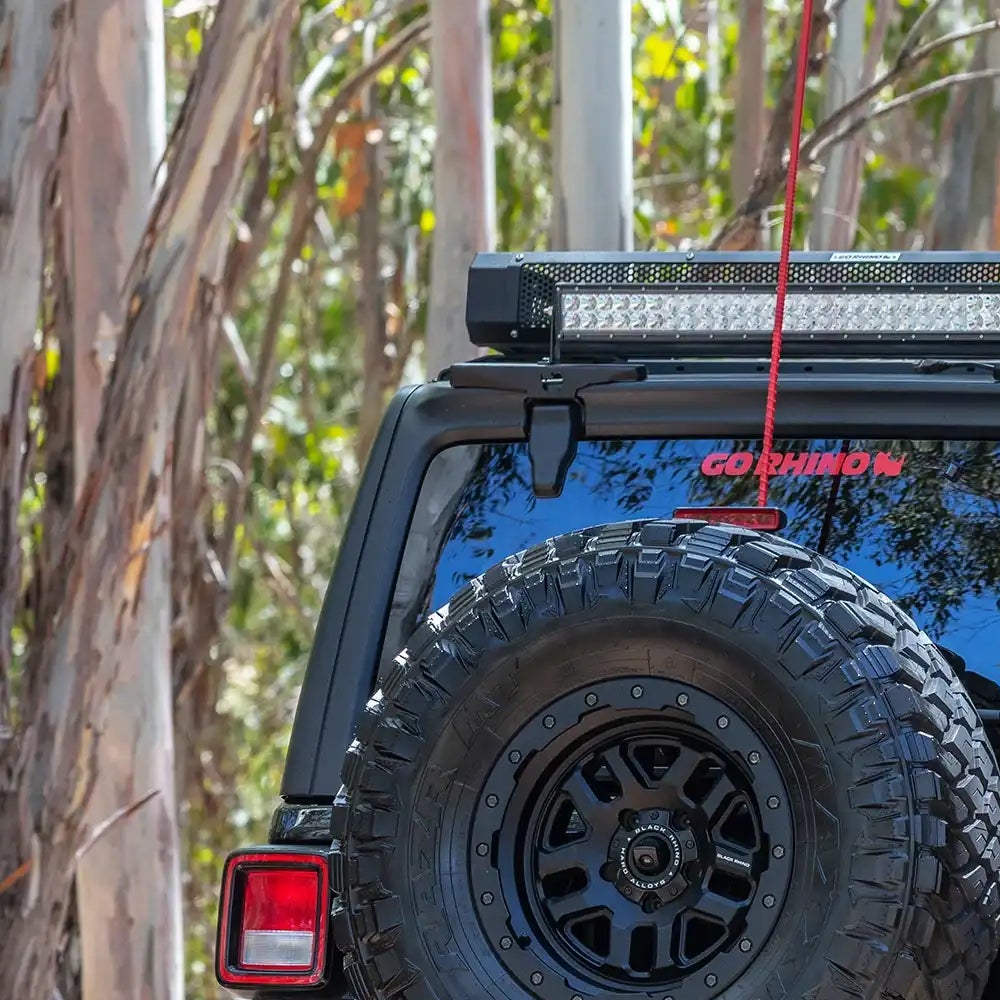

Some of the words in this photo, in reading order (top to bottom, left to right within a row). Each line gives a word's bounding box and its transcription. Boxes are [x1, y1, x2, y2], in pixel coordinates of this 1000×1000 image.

[701, 452, 753, 476] GO
[754, 452, 871, 476] RHINO
[634, 824, 667, 834] BLACK
[668, 834, 680, 866] RHINO
[716, 853, 733, 862] BLACK
[733, 859, 750, 868] RHINO
[620, 847, 629, 875] HARD
[630, 878, 666, 889] ALLOYS
